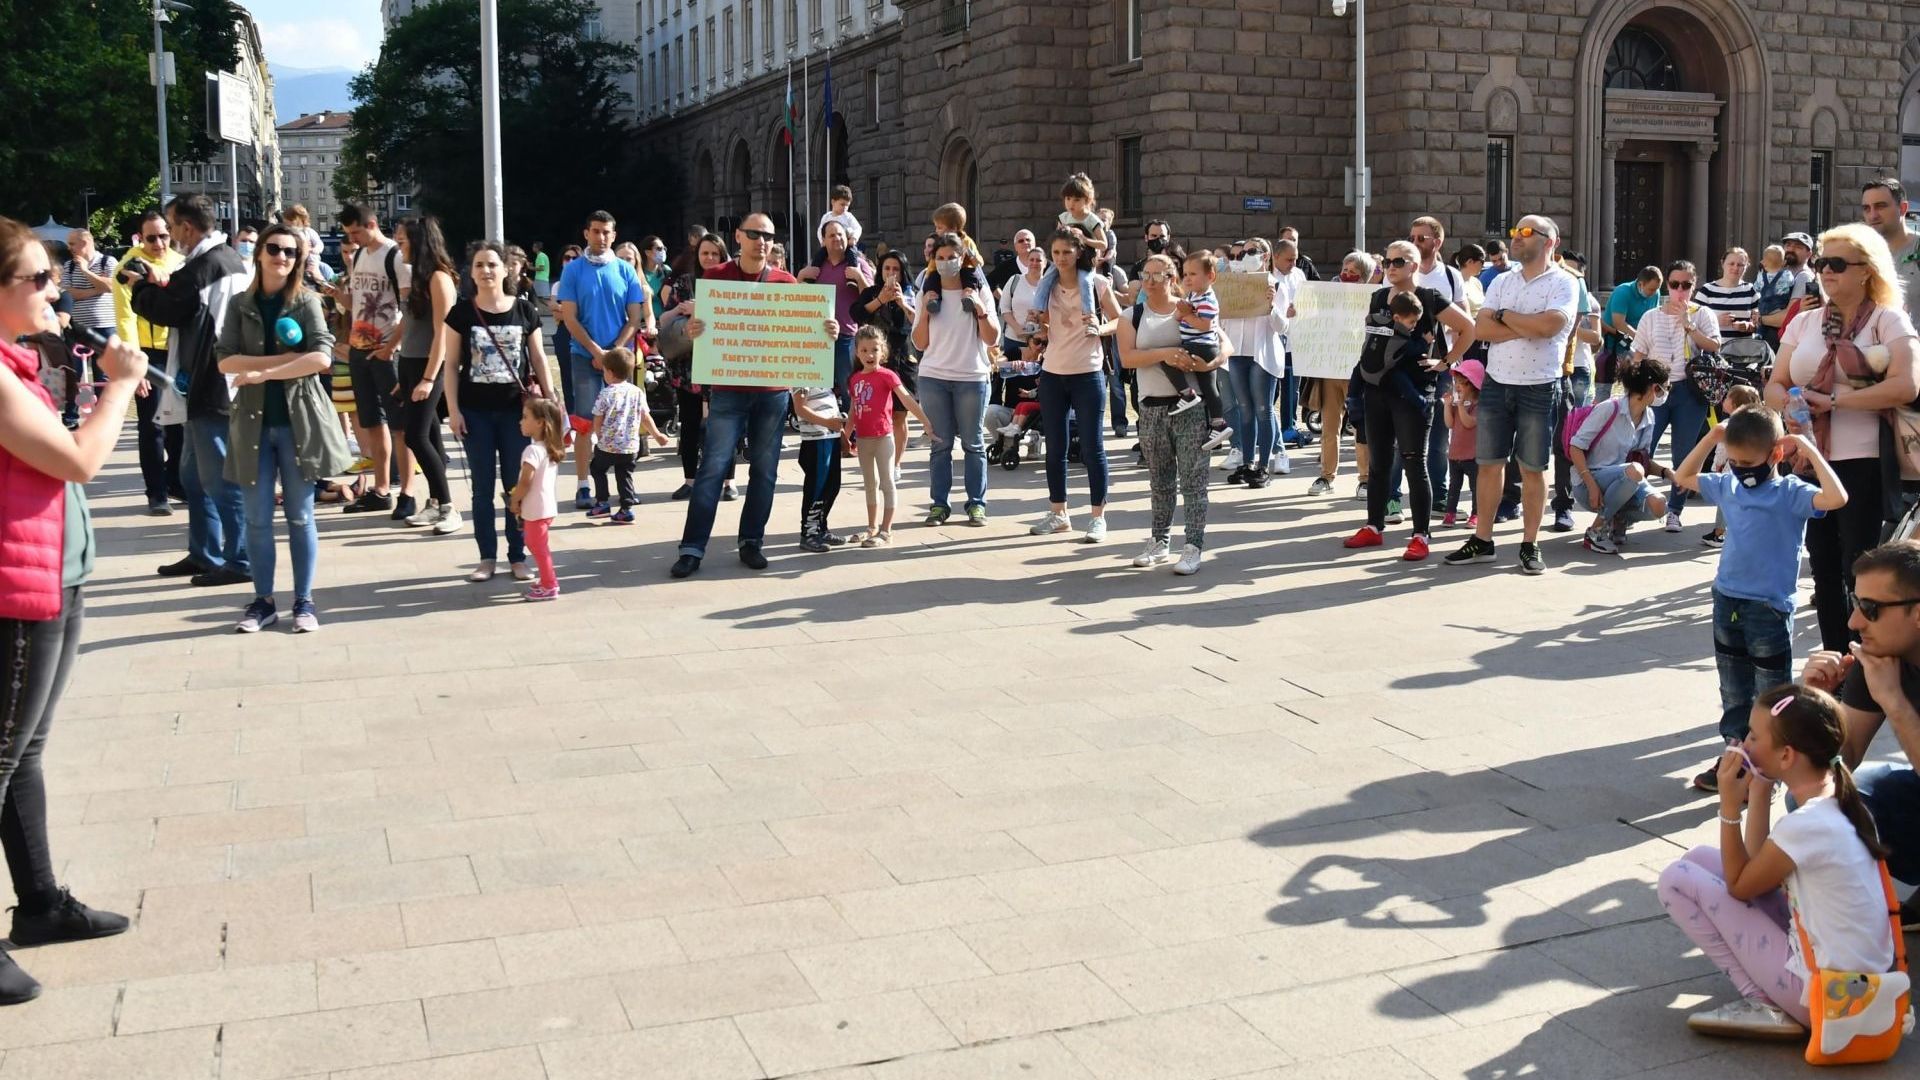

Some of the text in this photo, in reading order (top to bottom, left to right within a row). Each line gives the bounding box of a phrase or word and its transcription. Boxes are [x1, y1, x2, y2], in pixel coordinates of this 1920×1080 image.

[709, 289, 748, 300] ДЪЩЕРЯ
[751, 292, 764, 300] МИ
[714, 306, 725, 314] ЗА
[727, 307, 777, 317] ДЪРЖАВАТА
[713, 322, 737, 330] ХОДИ
[713, 338, 725, 346] НО
[741, 339, 789, 348] ЛОТАРИЯТА
[722, 353, 758, 363] КМЕТЪТ
[712, 368, 724, 376] НО
[727, 369, 779, 379] ПРОБЛЕМЪТ
